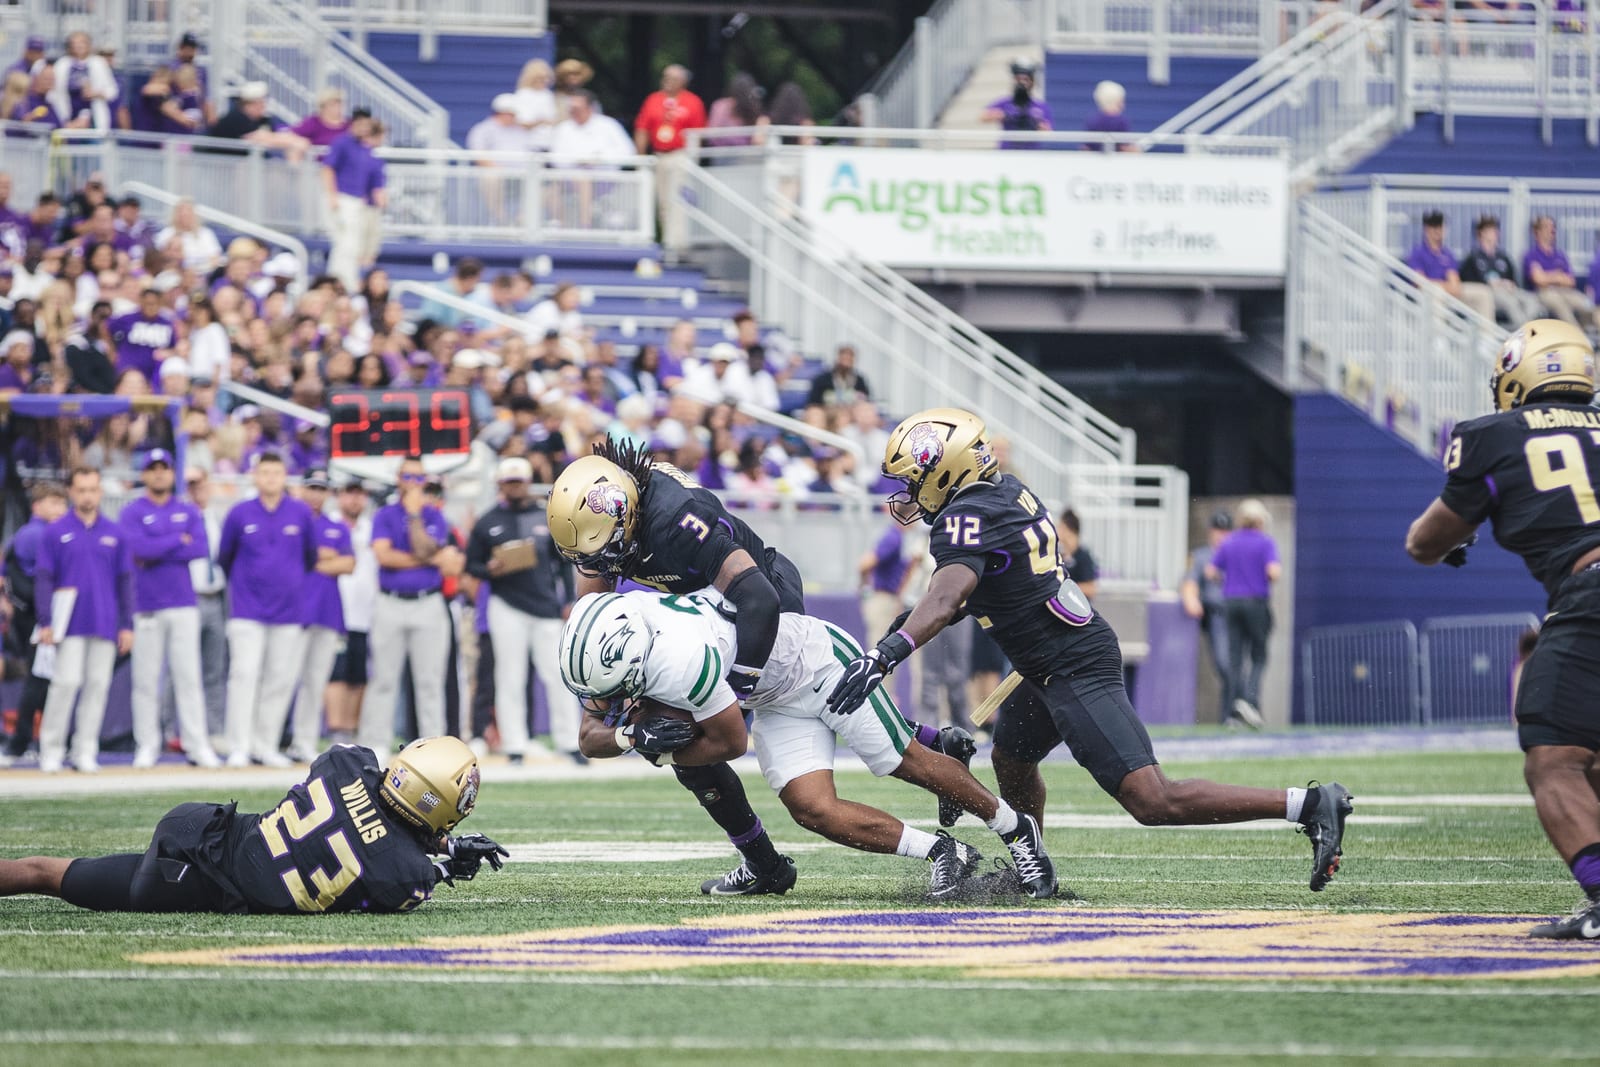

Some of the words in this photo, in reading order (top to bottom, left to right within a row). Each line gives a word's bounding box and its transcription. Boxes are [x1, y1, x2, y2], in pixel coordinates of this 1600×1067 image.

[823, 161, 1045, 231] Augusta
[1067, 176, 1127, 204] Care
[1132, 177, 1184, 205] that
[1191, 178, 1271, 208] makes
[934, 221, 1045, 256] Health
[1092, 229, 1106, 251] a
[331, 391, 470, 458] 2:39
[1523, 407, 1600, 429] McMULL
[1525, 430, 1600, 525] 9
[679, 513, 710, 543] 3
[944, 515, 983, 547] 42
[1022, 511, 1065, 583] 4
[339, 777, 389, 845] WILLIS
[258, 776, 364, 912] 23
